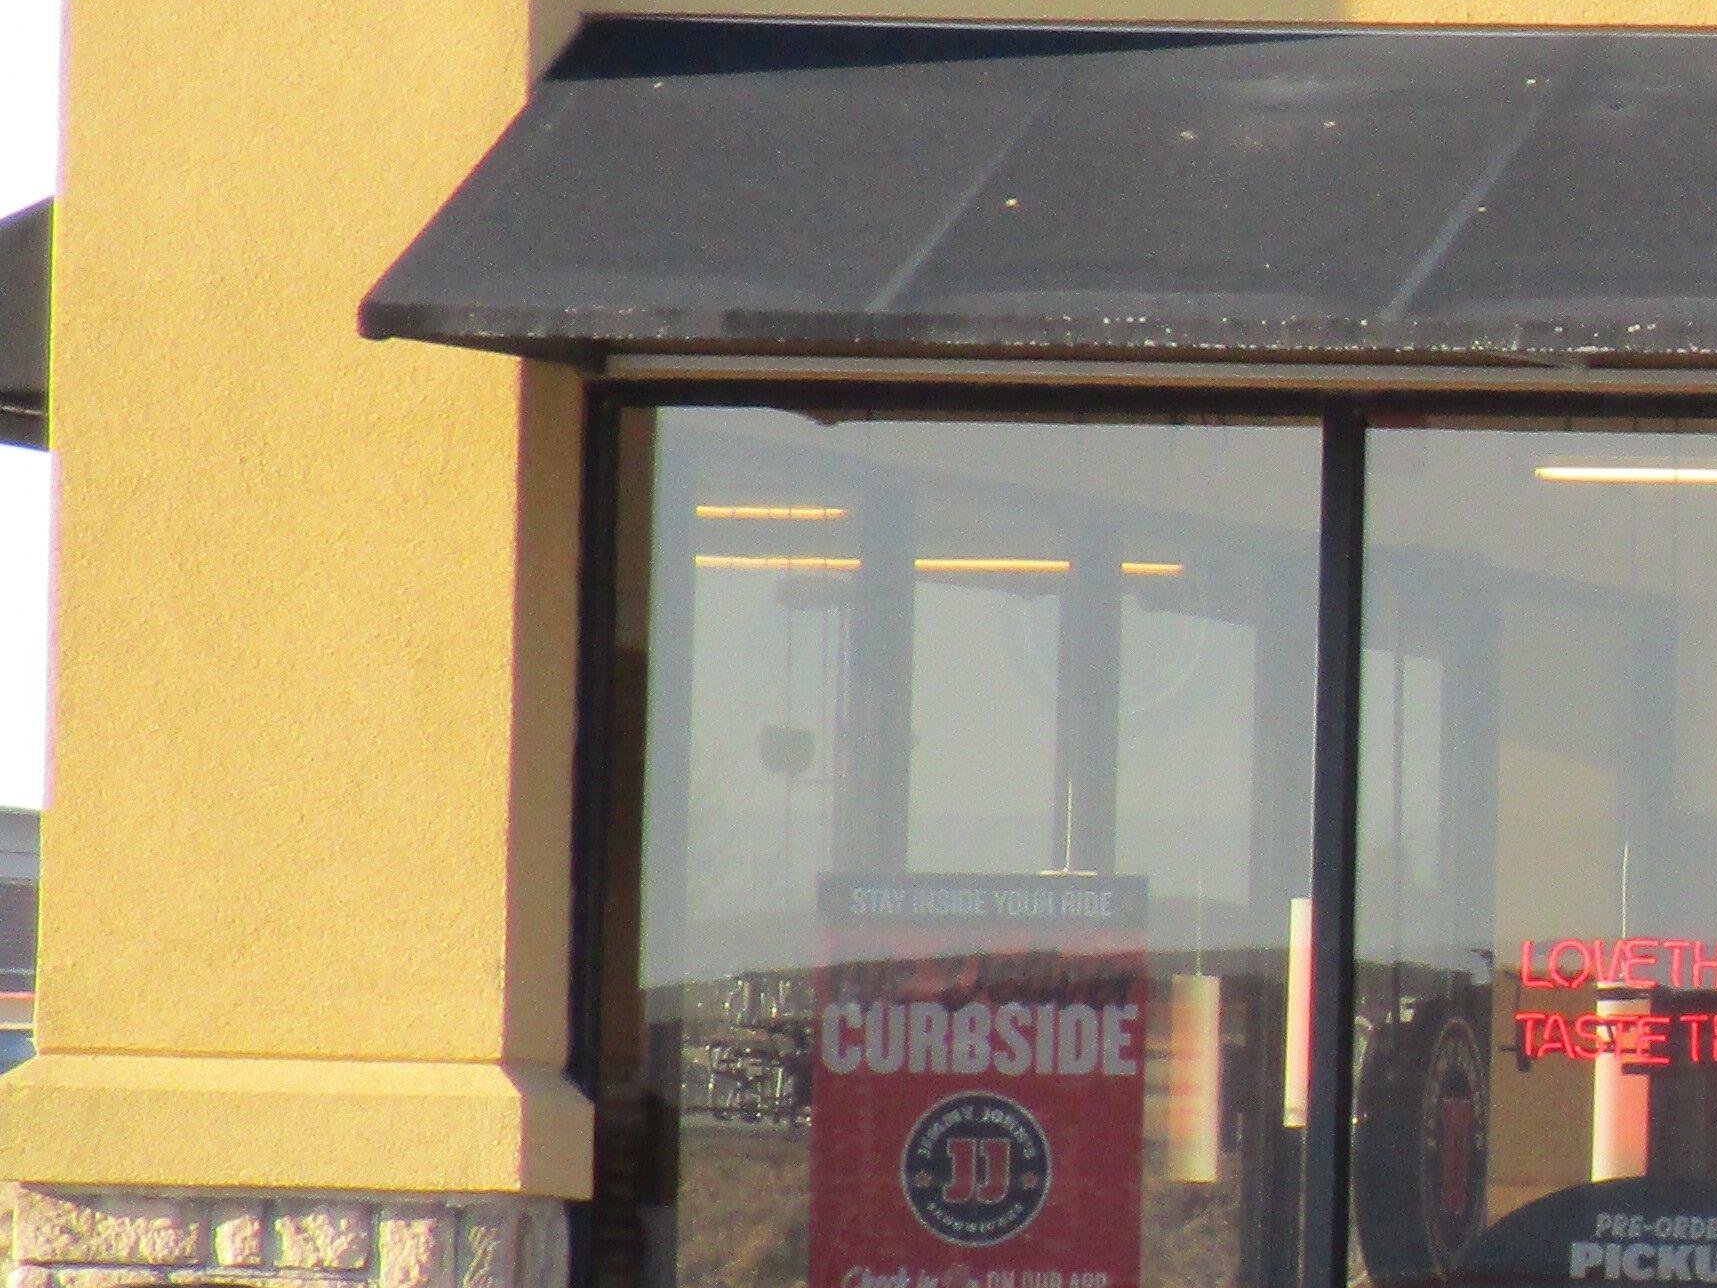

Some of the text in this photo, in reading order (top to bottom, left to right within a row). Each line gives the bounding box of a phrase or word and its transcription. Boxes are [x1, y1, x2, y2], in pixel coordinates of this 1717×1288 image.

[850, 887, 904, 914] STAY
[1520, 938, 1660, 989] LOVE
[821, 1001, 1140, 1077] CURBSIDE
[1514, 1011, 1672, 1065] TASTE
[942, 1138, 1012, 1204] JJ
